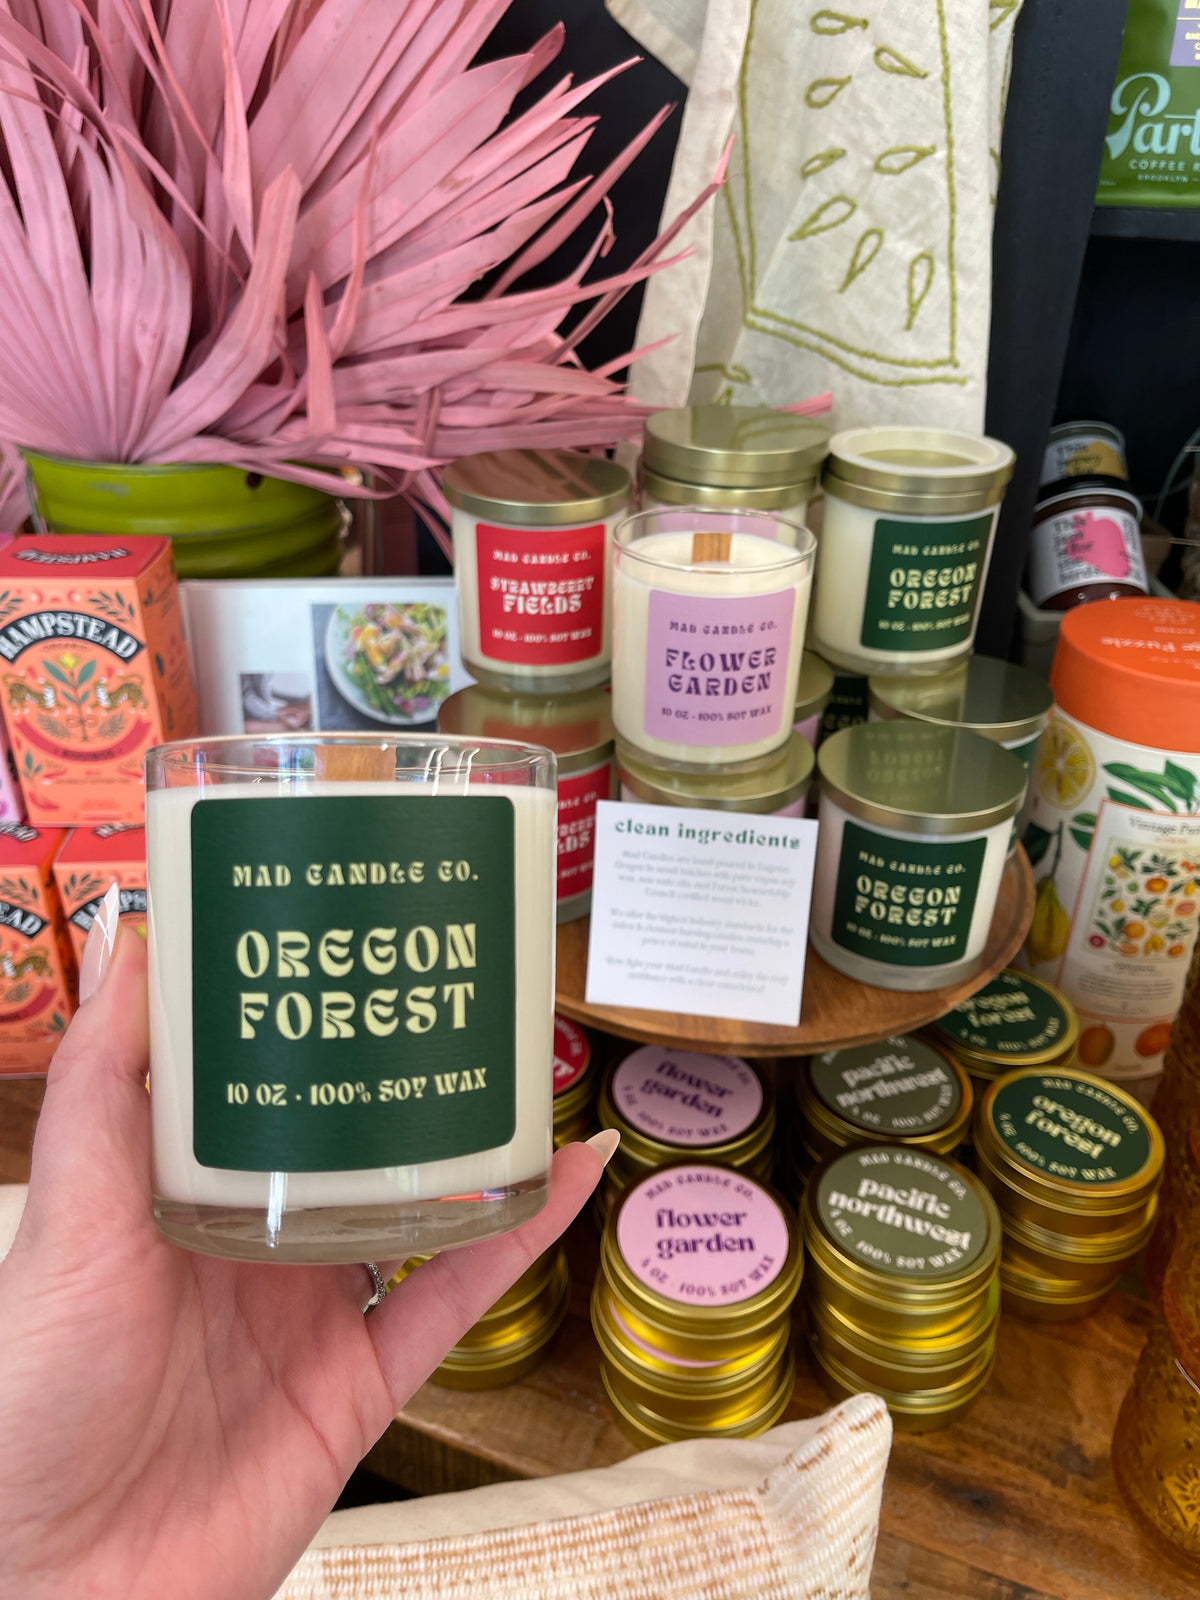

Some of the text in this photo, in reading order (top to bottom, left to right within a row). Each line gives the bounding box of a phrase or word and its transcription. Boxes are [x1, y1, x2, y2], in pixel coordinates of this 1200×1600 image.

[1129, 159, 1185, 171] COFFEE
[493, 549, 518, 562] MAD
[490, 575, 594, 595] STRAWBERRY
[890, 562, 977, 588] OREGON
[503, 593, 582, 615] FIELDS
[888, 583, 973, 609] FOREST
[0, 611, 138, 660] HAMPSTEAD
[670, 621, 697, 633] MAD
[703, 624, 754, 635] CANDLE
[666, 647, 776, 672] FLOWER
[668, 672, 771, 696] GARDEN
[662, 707, 672, 717] 10
[675, 710, 689, 720] OZ
[727, 710, 747, 721] SOY
[750, 705, 772, 718] WAX
[615, 818, 670, 838] clean
[678, 823, 801, 849] ingredients
[233, 860, 479, 887] MAD CANDLE CO.
[859, 850, 885, 867] MAD
[889, 861, 941, 876] CANDLE
[856, 874, 962, 907] OREGON
[854, 894, 957, 927] FOREST
[236, 923, 477, 979] OREGON
[240, 982, 474, 1040] FOREST
[656, 1060, 734, 1099] flower
[841, 1053, 916, 1088] pacific
[227, 1083, 249, 1104] 10
[255, 1083, 287, 1106] OZ
[310, 1081, 371, 1106] 100%
[378, 1076, 427, 1102] SOY
[434, 1067, 487, 1096] WAX
[640, 1078, 724, 1118] garden
[835, 1066, 949, 1108] northwest
[1024, 1108, 1105, 1159] forest
[1032, 1095, 1122, 1148] oregon
[858, 1152, 891, 1168] MAD
[893, 1152, 950, 1183] CANDLE
[644, 1176, 674, 1201] MAD
[675, 1172, 732, 1188] CANDLE
[858, 1178, 952, 1220] pacific
[655, 1207, 748, 1229] flower
[828, 1190, 972, 1250] northwest
[656, 1233, 756, 1260] garden
[856, 1240, 892, 1264] 100%
[896, 1255, 926, 1270] SOY
[928, 1246, 963, 1269] WAX
[679, 1282, 716, 1298] 100%
[720, 1280, 747, 1296] SOY
[748, 1254, 775, 1283] WAX
